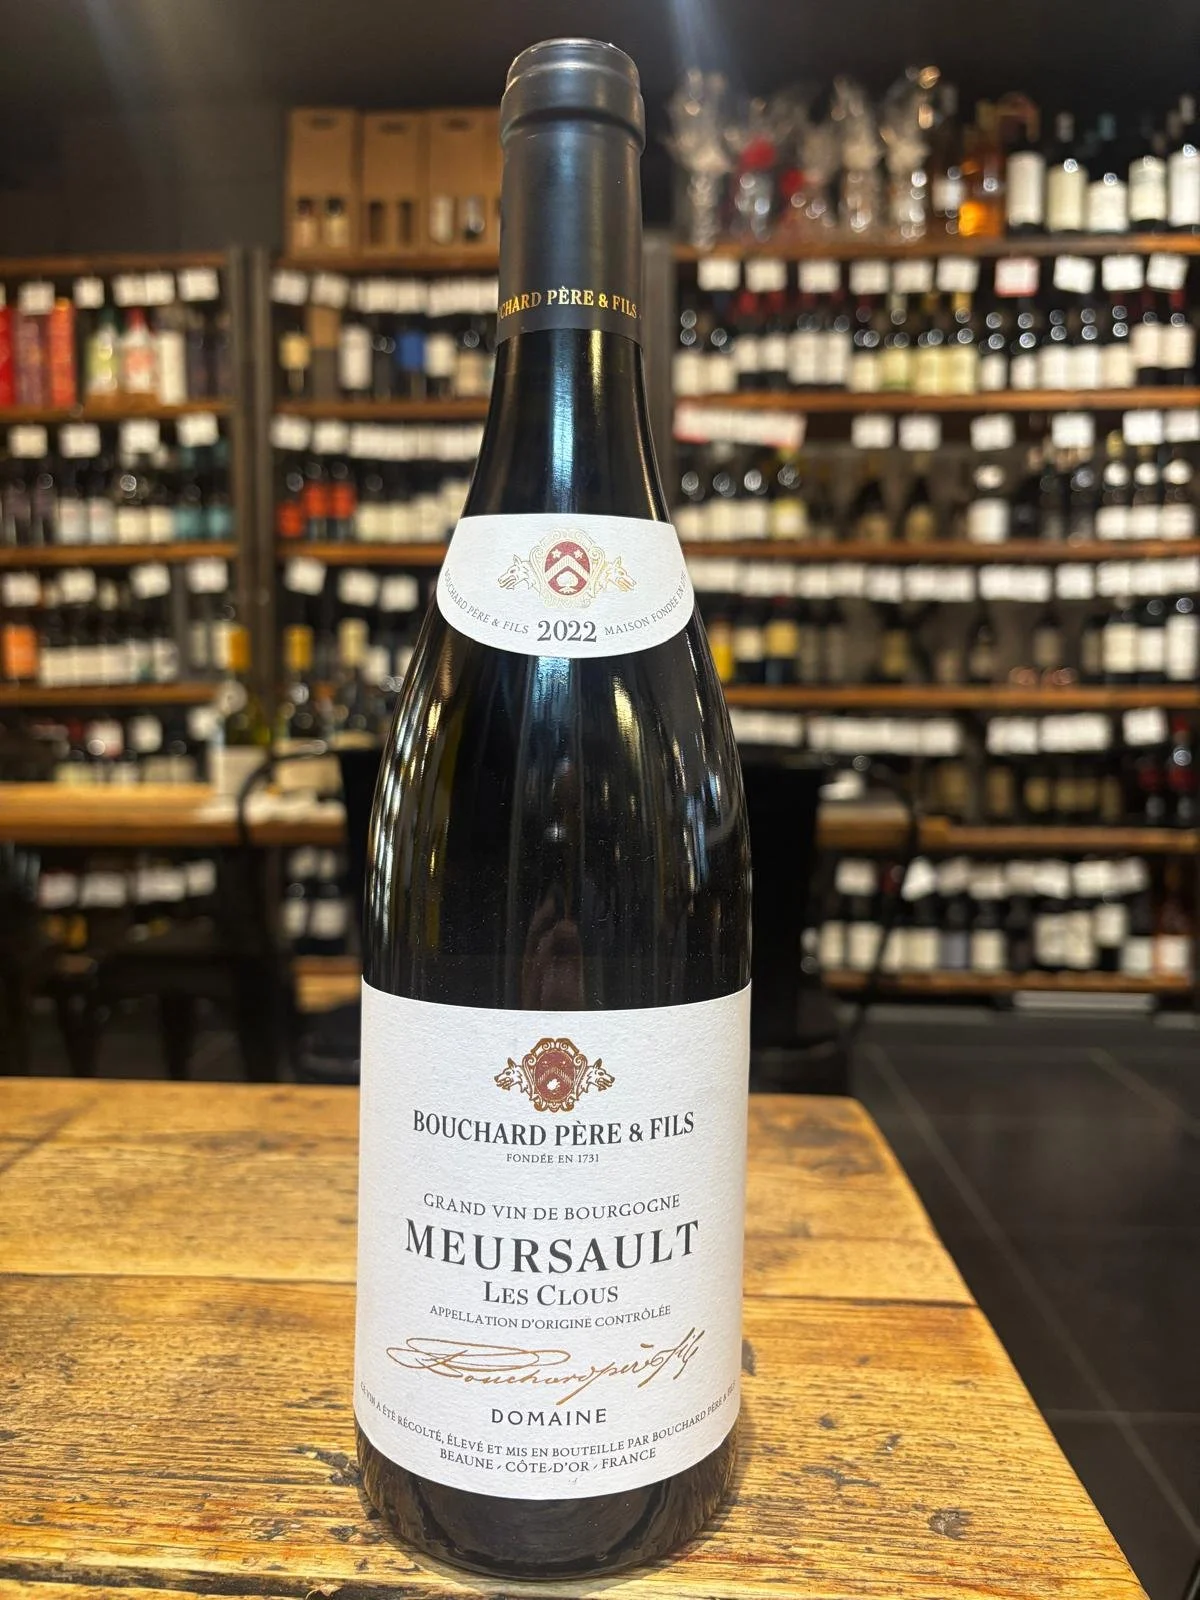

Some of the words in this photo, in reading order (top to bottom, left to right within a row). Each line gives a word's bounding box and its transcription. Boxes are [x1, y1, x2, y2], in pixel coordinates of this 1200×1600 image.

[500, 291, 542, 320] CHARD
[547, 286, 594, 306] PÈRE
[598, 292, 609, 308] &
[612, 295, 637, 319] FILS
[491, 618, 500, 627] &
[502, 620, 529, 634] FILS
[537, 620, 597, 642] 2022
[604, 616, 650, 636] MAISON
[413, 1109, 546, 1146] BOUCHARD
[554, 1120, 622, 1146] PÈRE
[629, 1123, 643, 1142] &
[649, 1111, 695, 1140] FILS
[506, 1153, 554, 1164] FONDÉE
[558, 1154, 573, 1163] EN
[578, 1153, 599, 1164] 1731
[424, 1193, 486, 1217] GRAND
[493, 1204, 527, 1220] VIN
[533, 1207, 559, 1221] DE
[564, 1194, 680, 1221] BOURGOGNE
[405, 1218, 699, 1274] MEURSAULT
[430, 1305, 518, 1328] APPELLATION
[521, 1317, 592, 1330] D'ORIGINE
[595, 1304, 671, 1328] CONTRÔLÉE
[491, 1408, 607, 1426] DOMAINE
[397, 1415, 445, 1445] RÉCOLTÉ,
[447, 1432, 484, 1453] ÉLEVÉ
[487, 1445, 502, 1455] ET
[506, 1447, 528, 1457] MIS
[532, 1447, 548, 1457] EN
[552, 1441, 625, 1458] BOUTEILLE
[627, 1434, 649, 1449] PAR
[652, 1410, 707, 1442] BOUCHARD
[440, 1447, 494, 1470] BEAUNE
[602, 1447, 656, 1470] FRANCE
